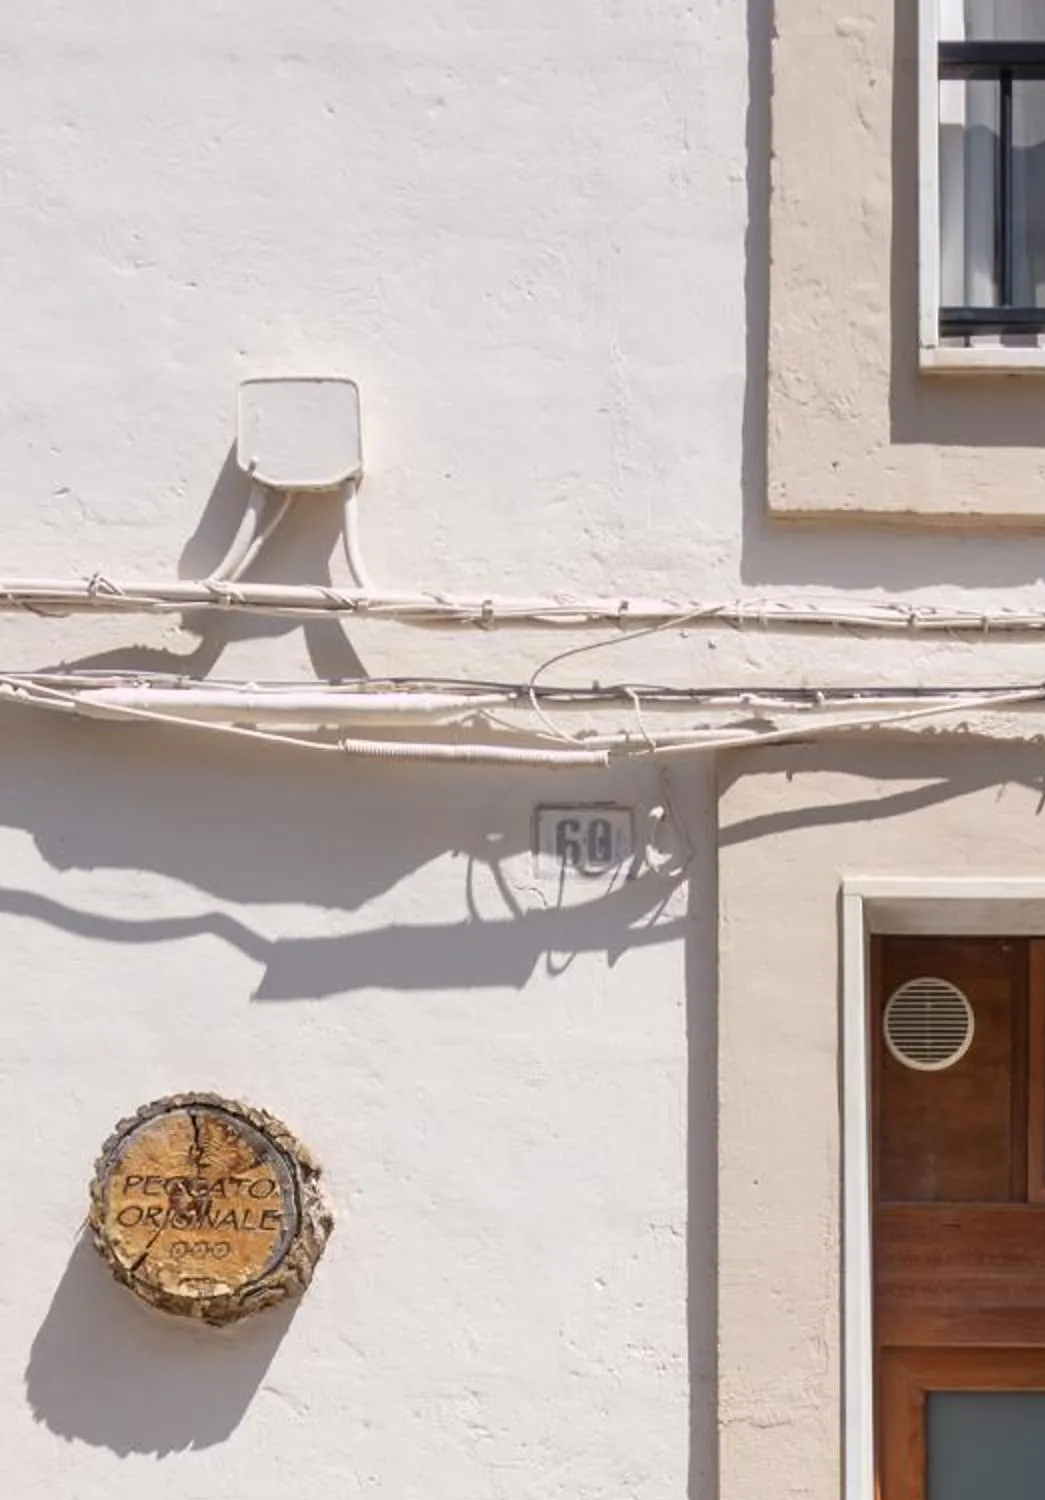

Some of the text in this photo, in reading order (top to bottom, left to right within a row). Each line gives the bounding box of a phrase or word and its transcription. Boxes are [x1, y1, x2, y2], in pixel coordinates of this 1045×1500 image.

[556, 818, 612, 866] 60
[122, 1174, 277, 1199] PECCATO
[116, 1205, 282, 1231] ORIGINALE
